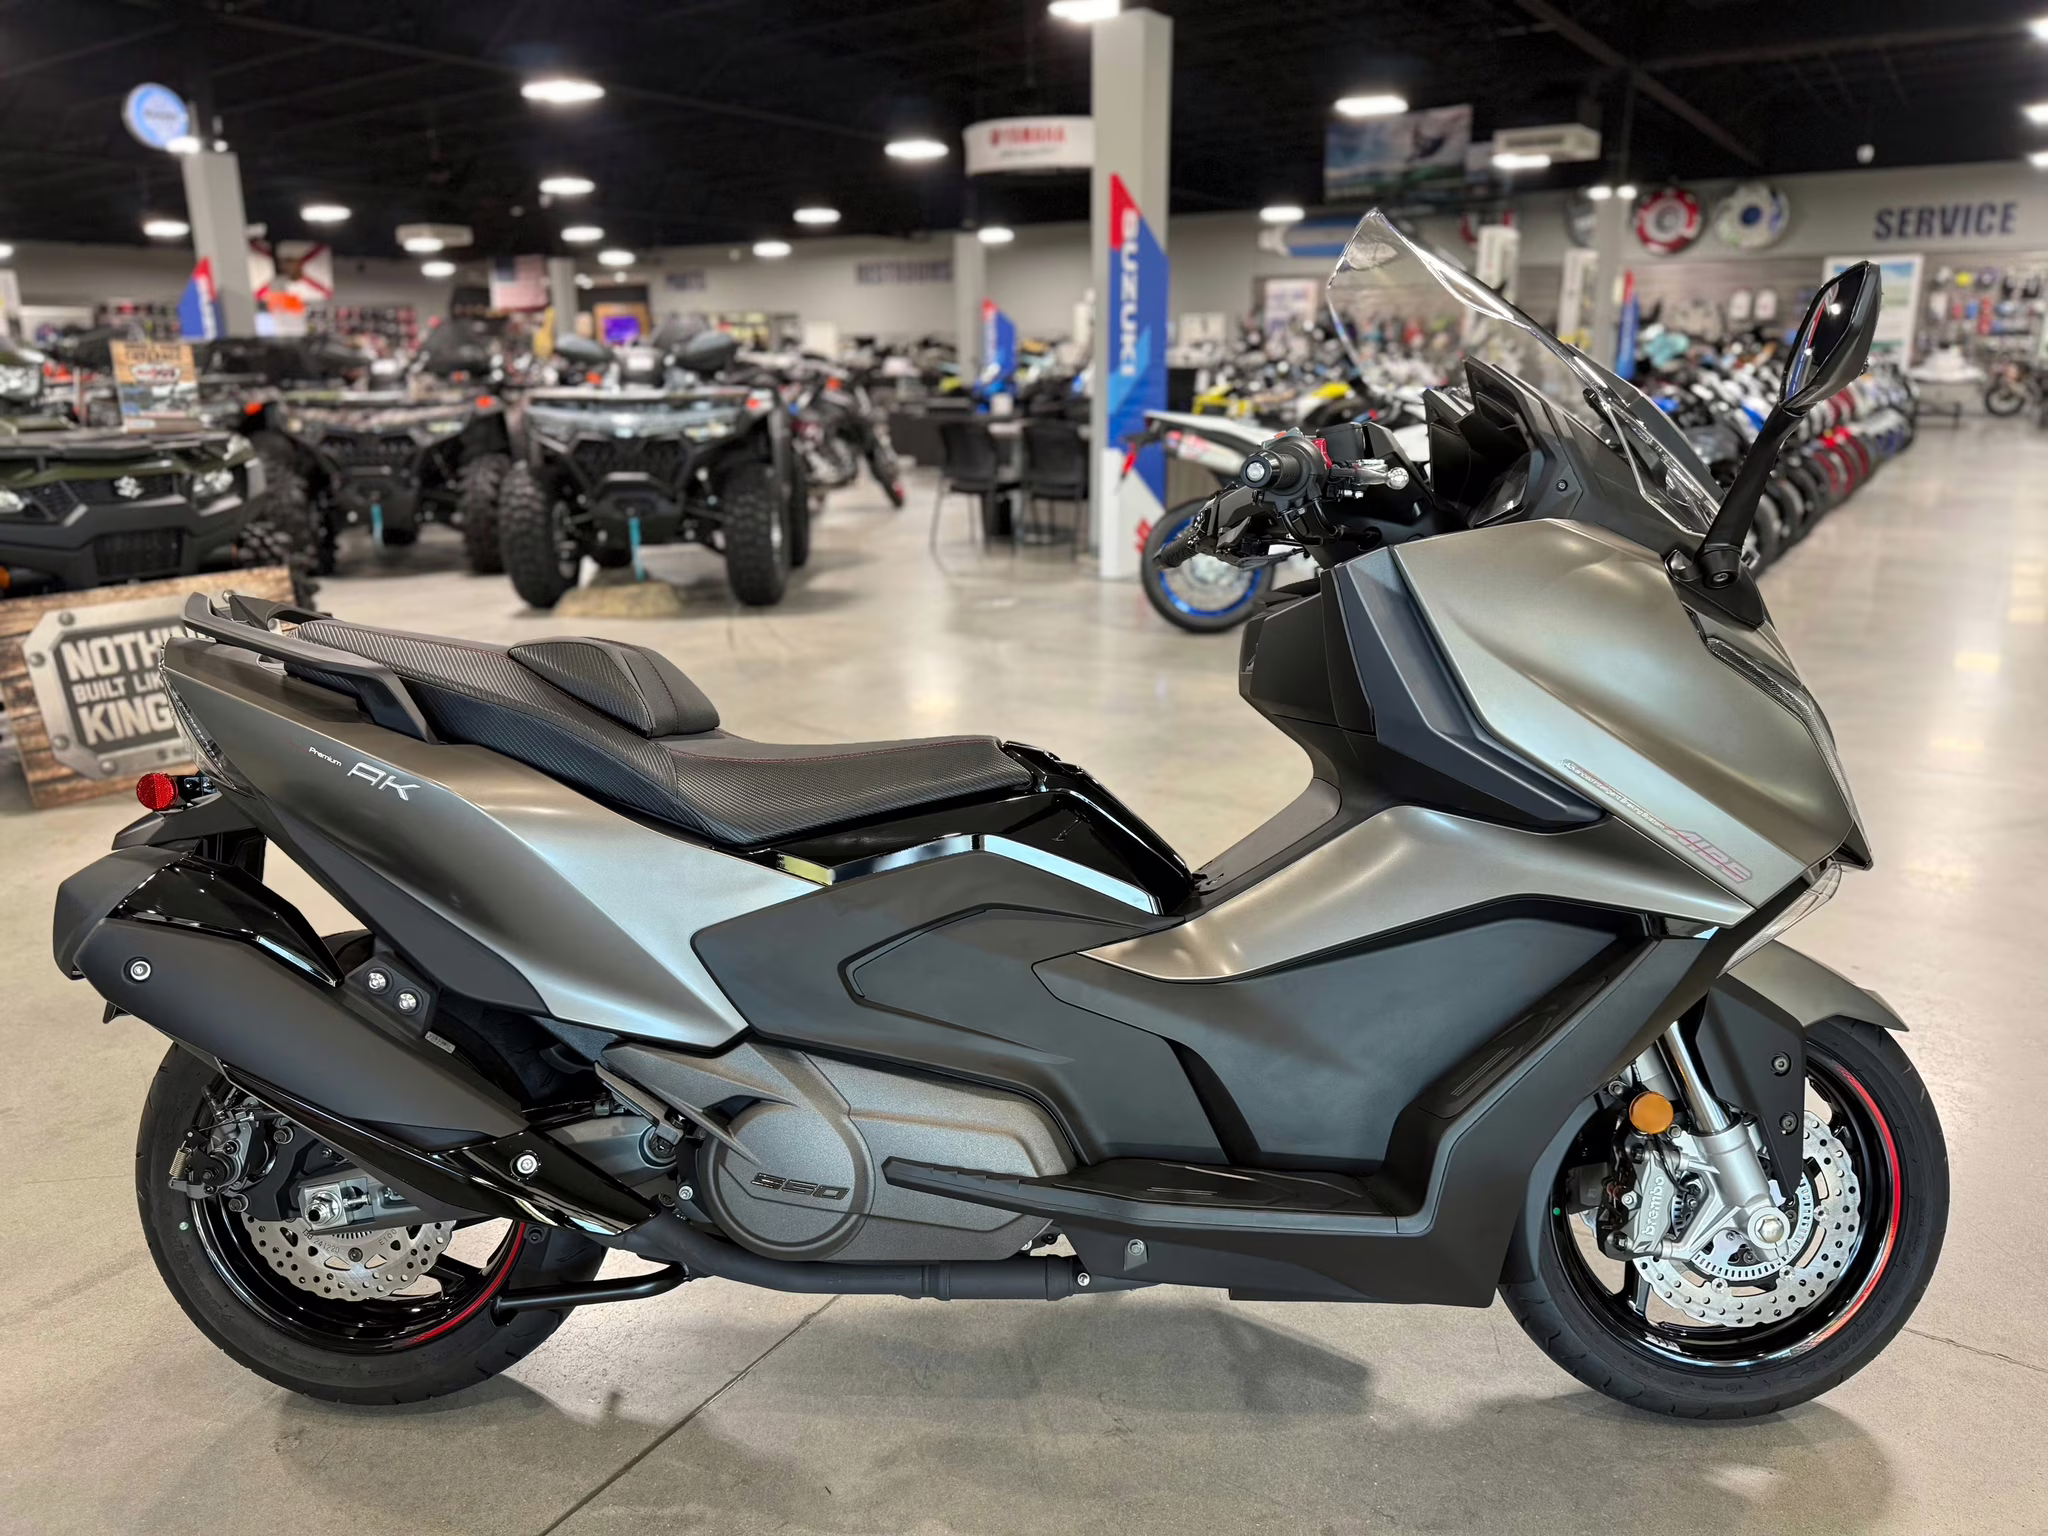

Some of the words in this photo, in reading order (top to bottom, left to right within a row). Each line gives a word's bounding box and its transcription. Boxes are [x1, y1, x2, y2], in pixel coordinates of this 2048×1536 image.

[1874, 202, 2018, 240] SERVICE
[1120, 208, 1139, 376] SUZUKI
[71, 677, 125, 703] BUILT
[132, 671, 166, 693] LIK
[78, 692, 174, 745] KING
[308, 746, 342, 767] Premium
[1641, 1176, 1665, 1236] brembo
